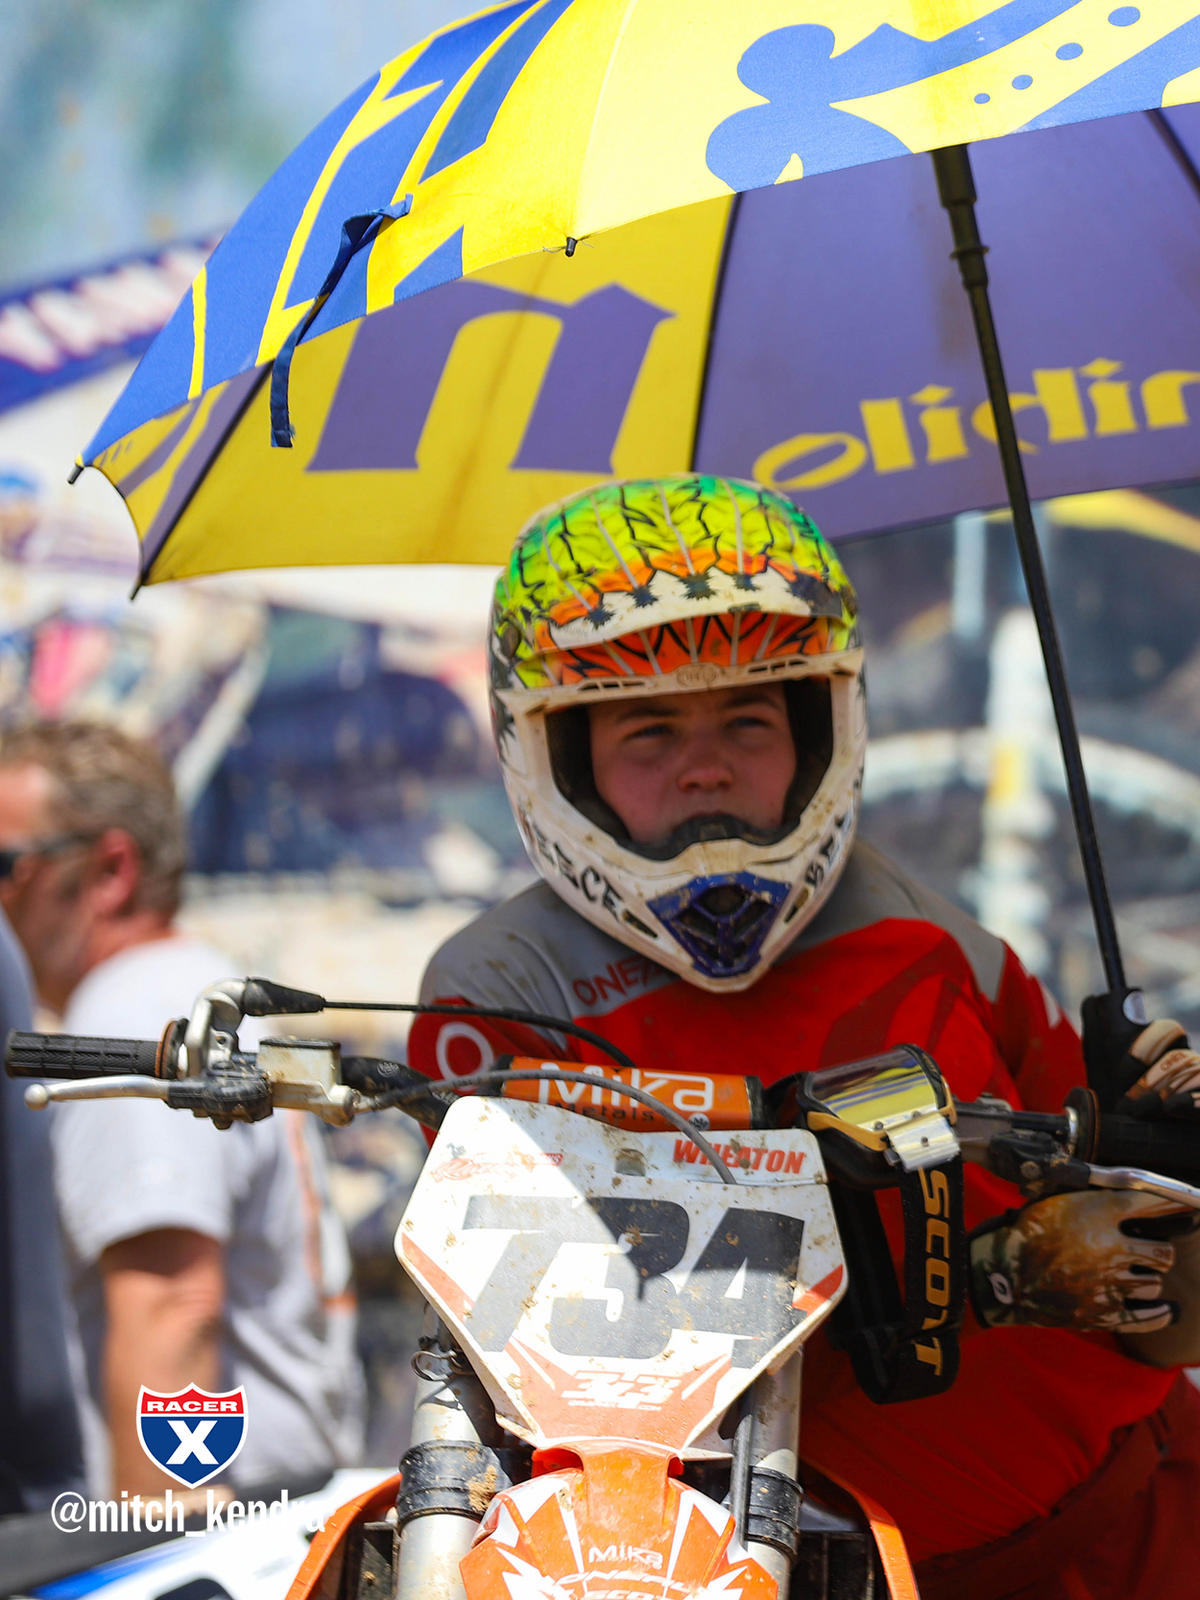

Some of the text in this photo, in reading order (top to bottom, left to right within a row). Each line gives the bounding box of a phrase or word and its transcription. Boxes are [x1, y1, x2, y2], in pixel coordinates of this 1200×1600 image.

[539, 1062, 715, 1112] Mika
[672, 1138, 807, 1175] WHEATON
[462, 1195, 805, 1369] 734
